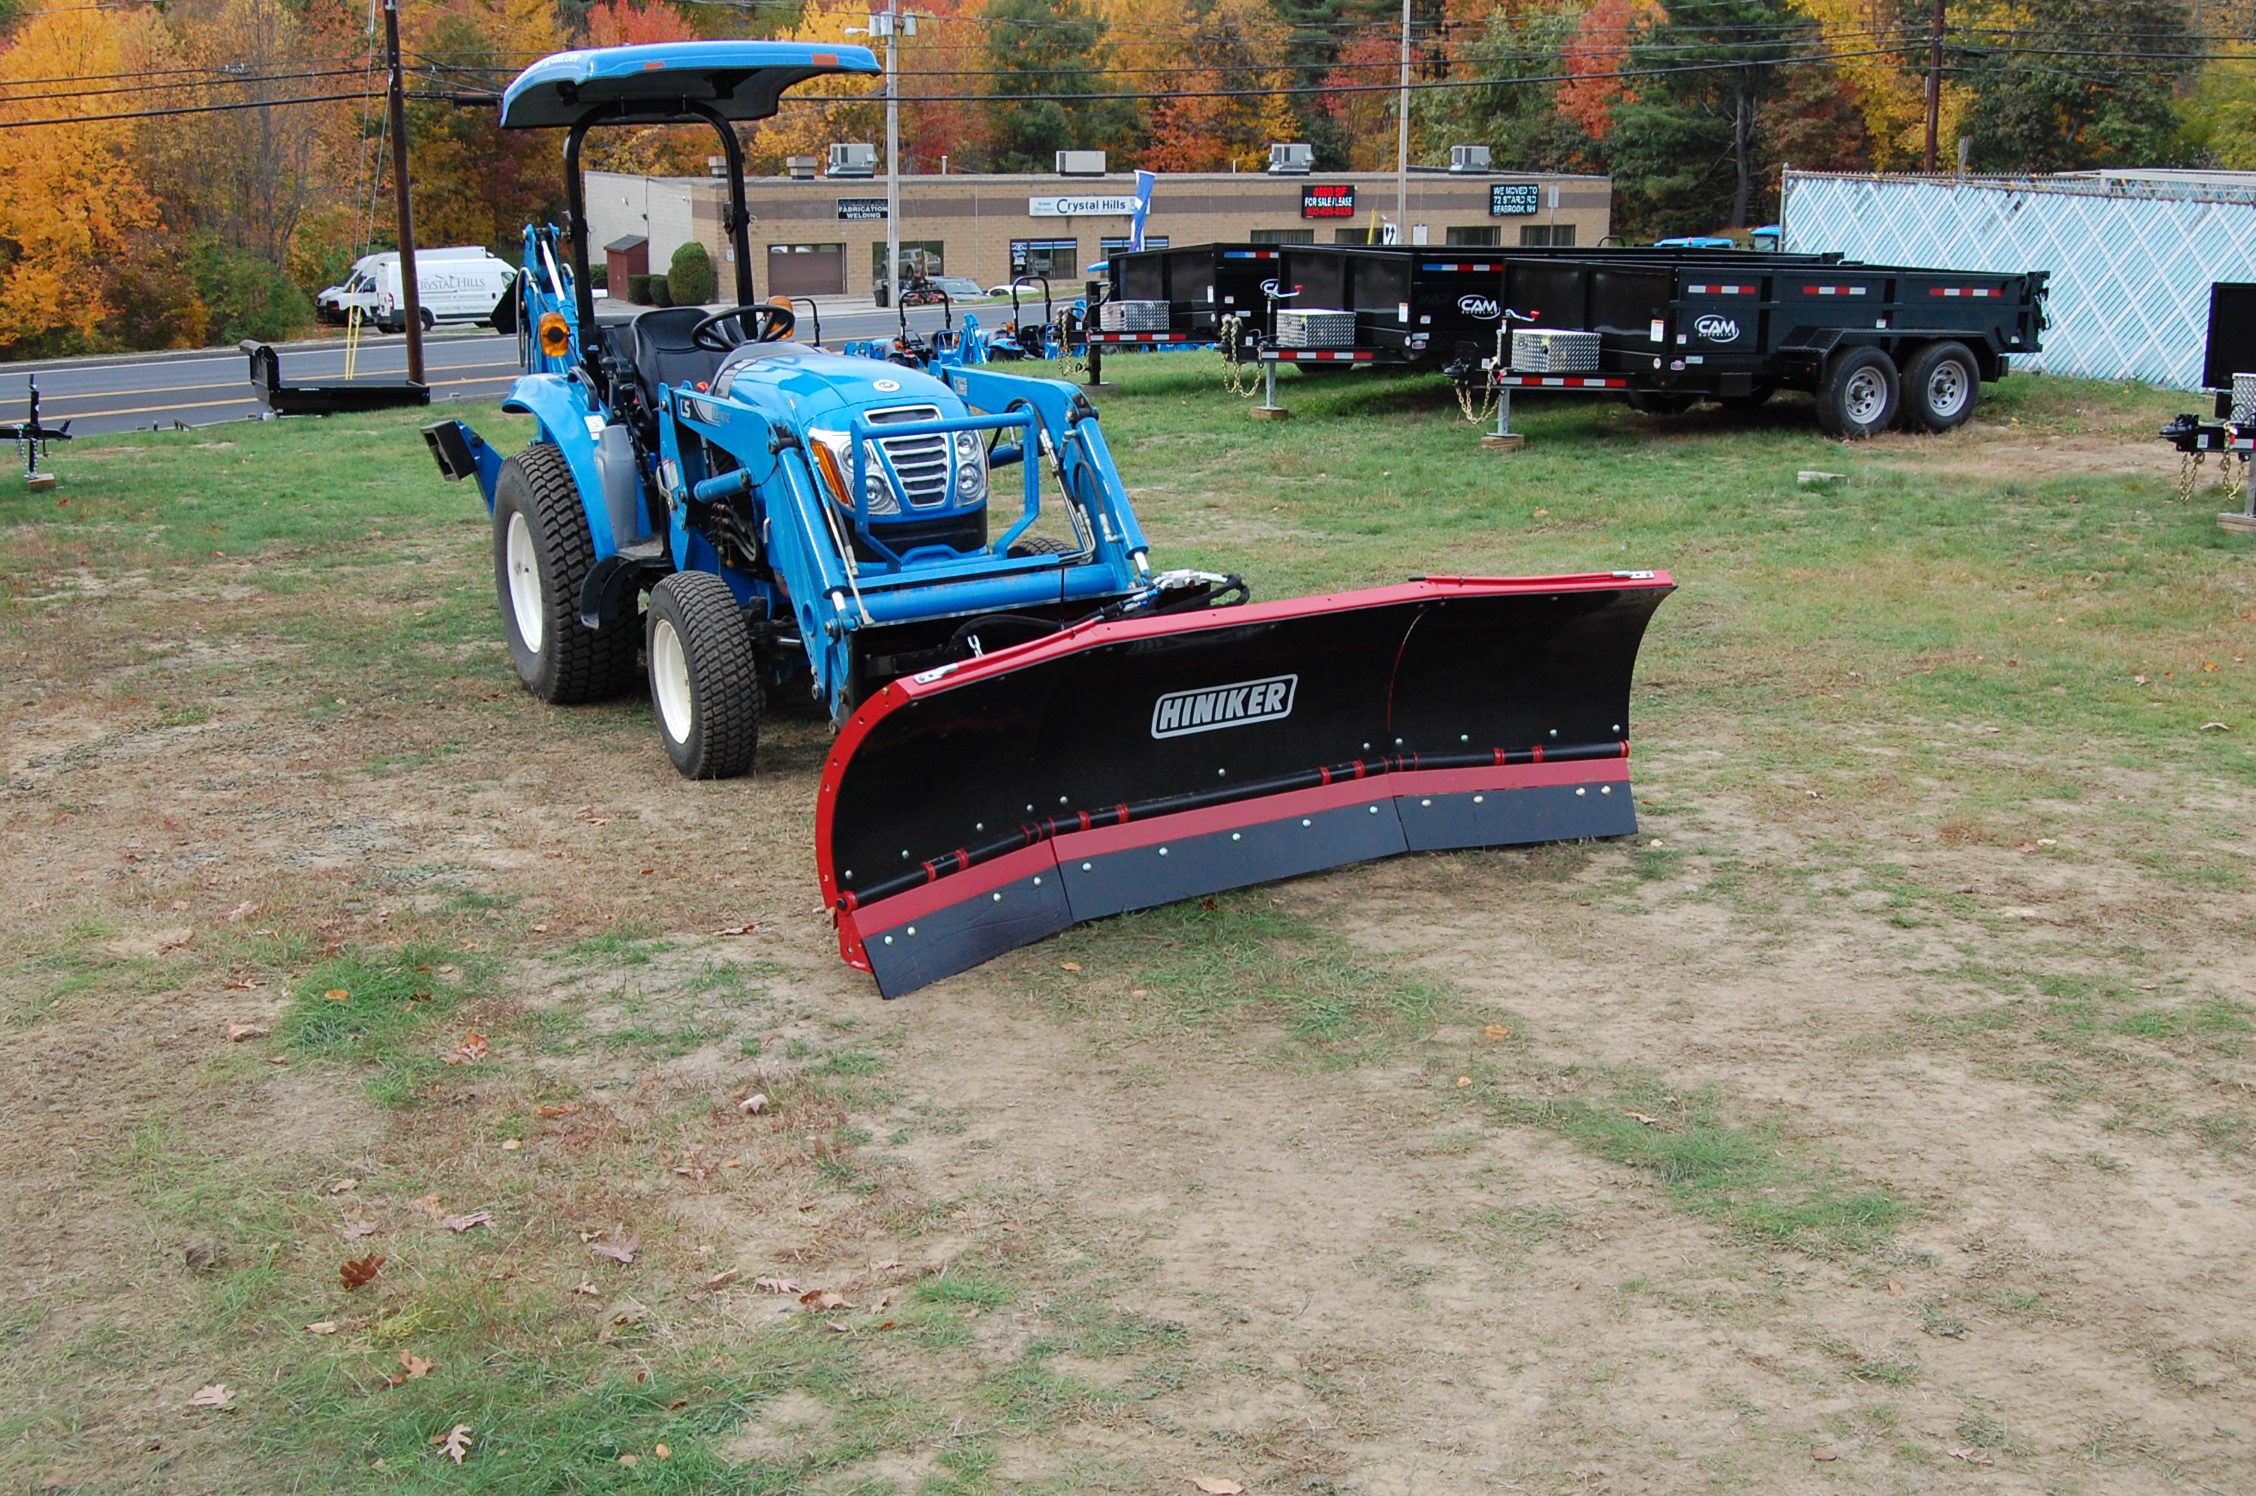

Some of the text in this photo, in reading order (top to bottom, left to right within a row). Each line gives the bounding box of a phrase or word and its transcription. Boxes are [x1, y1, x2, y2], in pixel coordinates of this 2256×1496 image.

[1493, 186, 1538, 195] WE MOVED TO
[1056, 198, 1099, 214] Crystal
[1102, 200, 1126, 210] Hills
[1304, 196, 1317, 207] FOR
[1493, 195, 1502, 204] 72
[1526, 205, 1536, 213] NH
[420, 277, 486, 291] RYSTAL HILLS
[1461, 299, 1498, 313] CAM
[1698, 319, 1736, 334] CAM
[679, 398, 691, 419] LS
[1158, 682, 1287, 730] HINIKER
